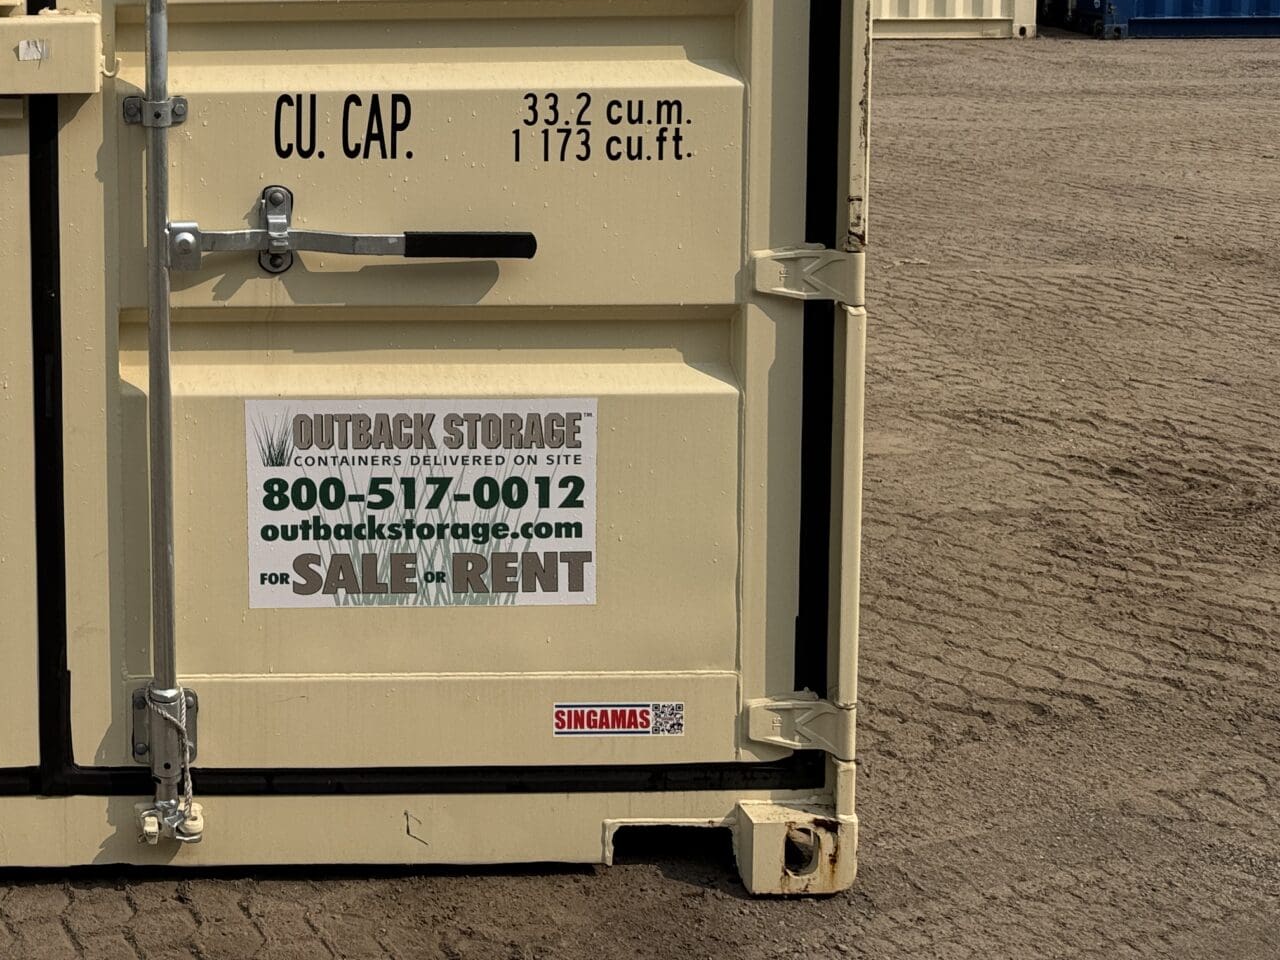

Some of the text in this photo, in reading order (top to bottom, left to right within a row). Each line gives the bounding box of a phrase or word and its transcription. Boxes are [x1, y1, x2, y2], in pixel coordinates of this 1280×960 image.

[274, 93, 413, 159] CU. CAP.
[523, 92, 692, 126] 33.2 cu.m.
[512, 126, 692, 162] 1 173 cu.ft.
[292, 412, 436, 451] OUTBACK
[443, 412, 582, 449] STORAGE
[294, 454, 582, 467] CONTAINERS DELIVERED ON SITE
[262, 475, 585, 511] 800-517-0012
[260, 515, 582, 545] outbackstorage.com
[260, 551, 592, 596] FOR SALE OR RENT
[554, 709, 650, 729] SINGAMAS
